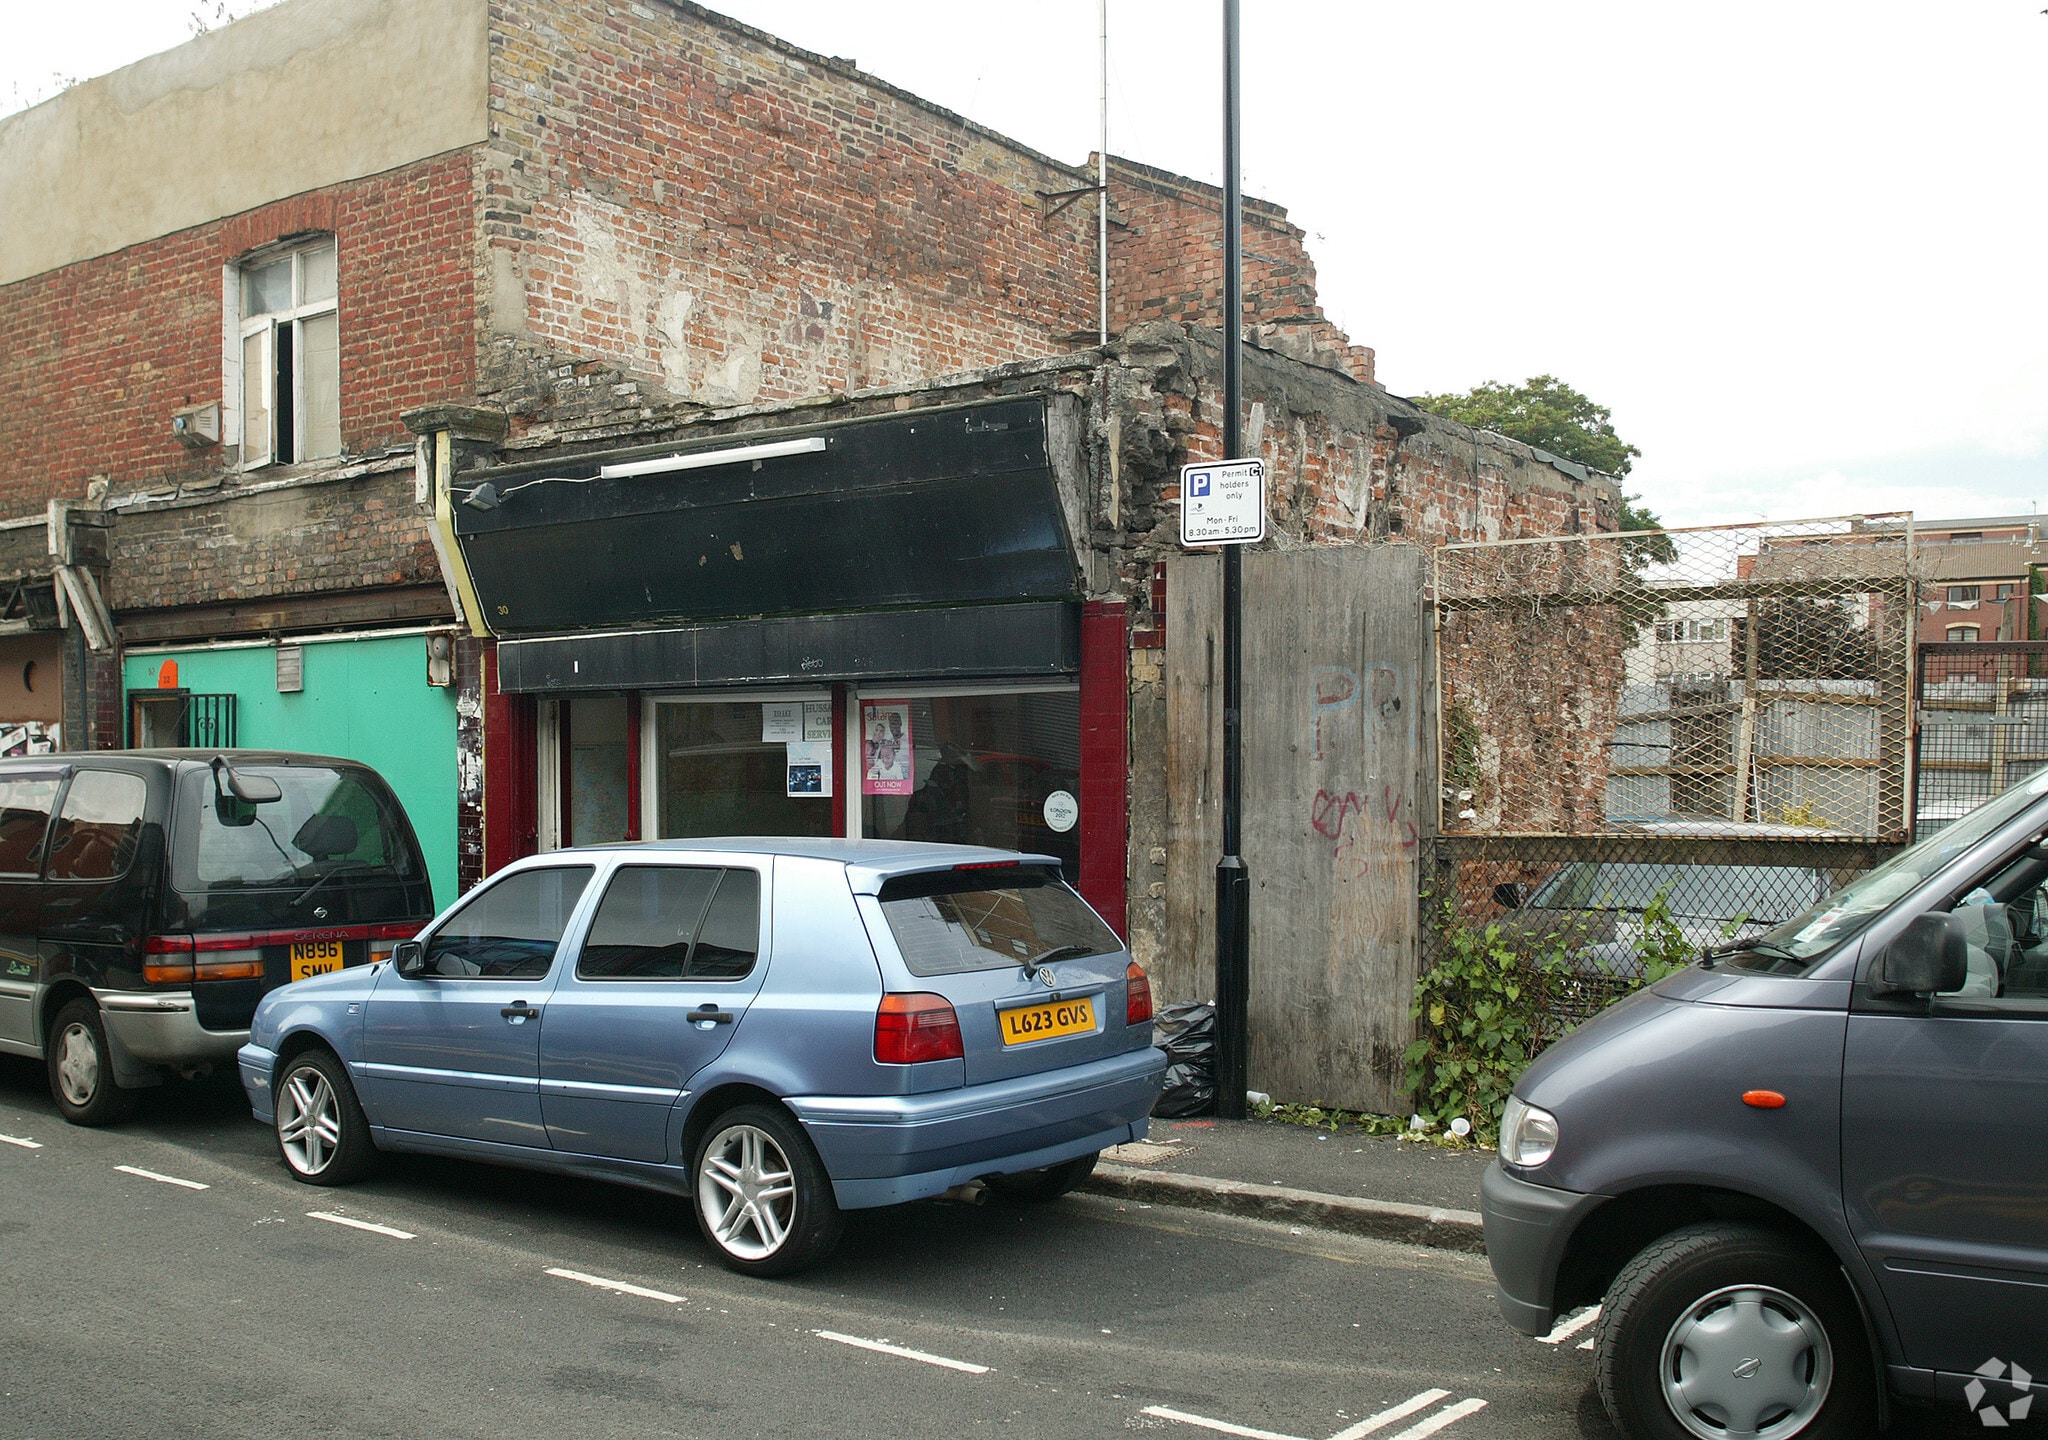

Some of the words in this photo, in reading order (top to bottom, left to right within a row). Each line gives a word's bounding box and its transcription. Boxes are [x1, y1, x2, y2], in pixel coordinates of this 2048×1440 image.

[1222, 470, 1247, 478] Permit
[1220, 480, 1249, 489] holders
[1226, 492, 1242, 500] only
[1228, 515, 1239, 523] Fri
[497, 605, 509, 616] 30
[295, 931, 349, 940] SERENA
[294, 942, 338, 960] N896
[1010, 1010, 1053, 1035] L623
[1056, 1004, 1088, 1027] GVS
